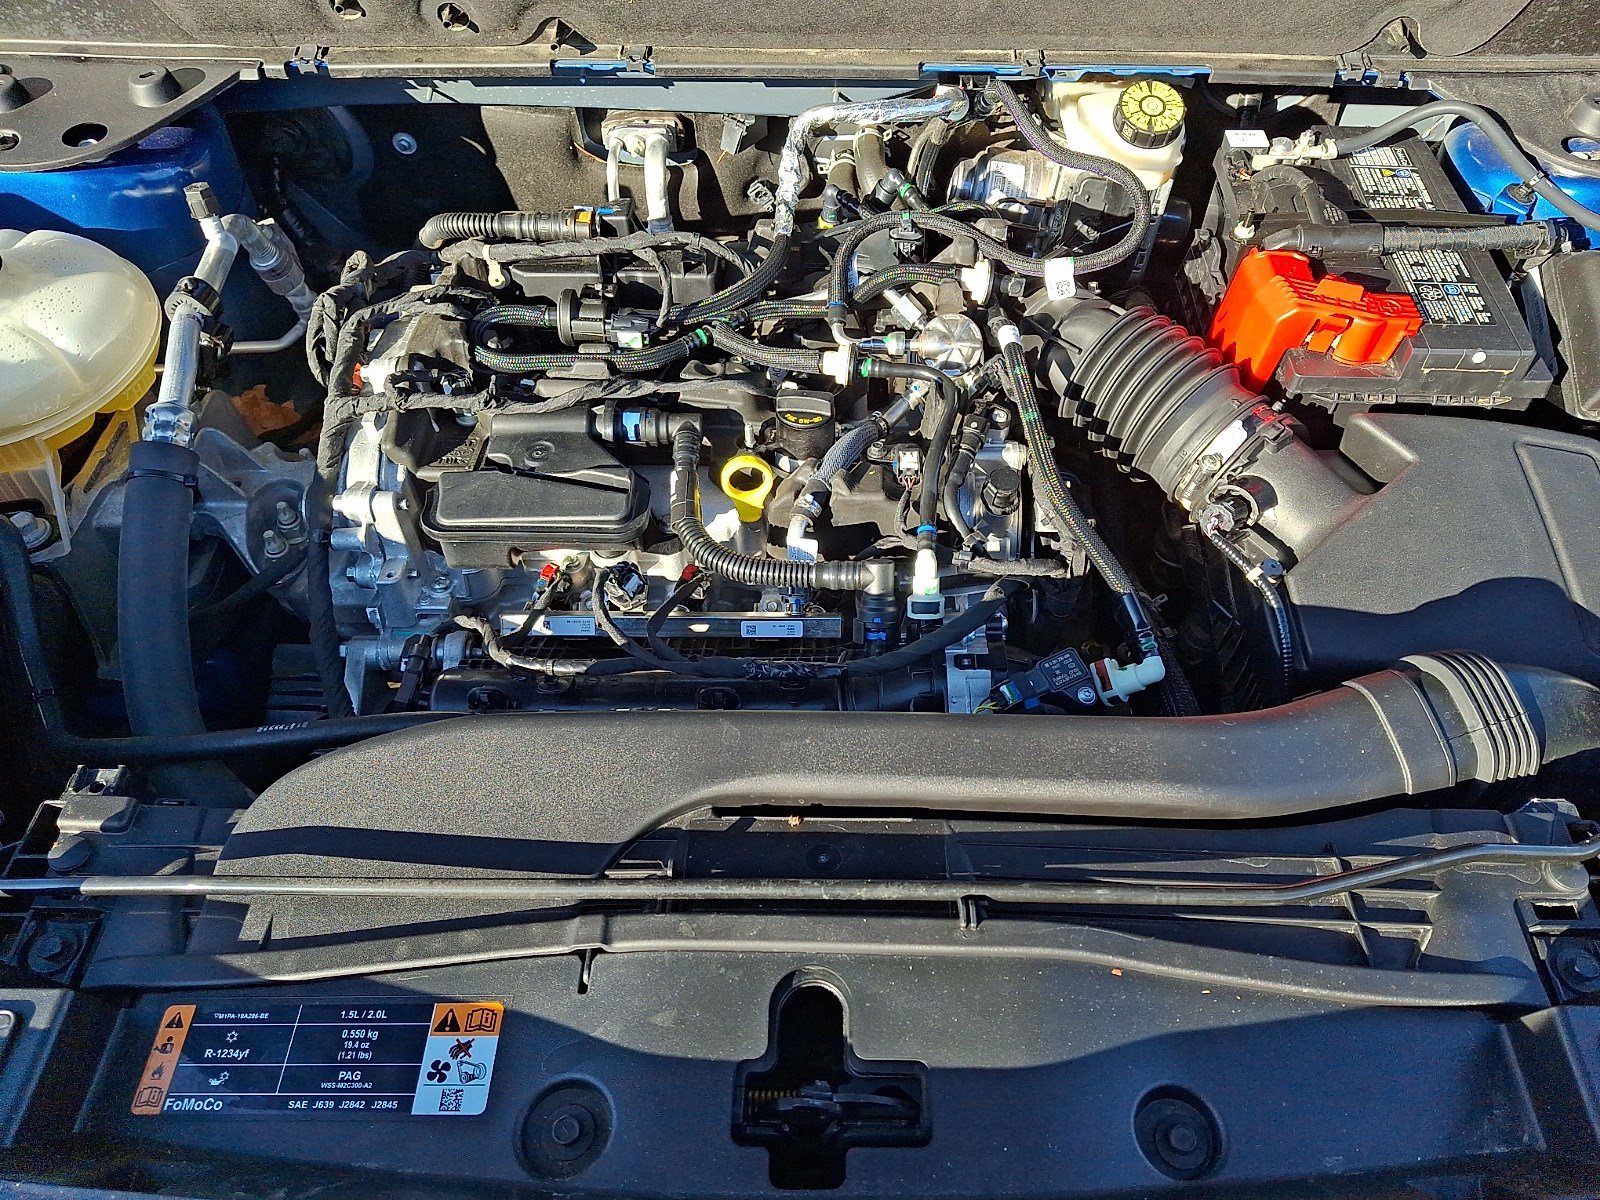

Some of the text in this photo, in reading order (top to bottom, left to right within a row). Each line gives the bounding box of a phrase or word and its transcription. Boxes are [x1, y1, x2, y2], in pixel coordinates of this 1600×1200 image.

[340, 1010, 388, 1019] 1.5L / 2.0L
[341, 1029, 379, 1041] 0.550 kg
[343, 1040, 360, 1049] 19.4
[204, 1048, 251, 1060] R-1234yf
[337, 1050, 373, 1061] (1.21 lbs)
[338, 1070, 362, 1081] PAG
[163, 1097, 224, 1111] FoMoCo
[287, 1100, 399, 1109] SAE J639 J2842 J2845
